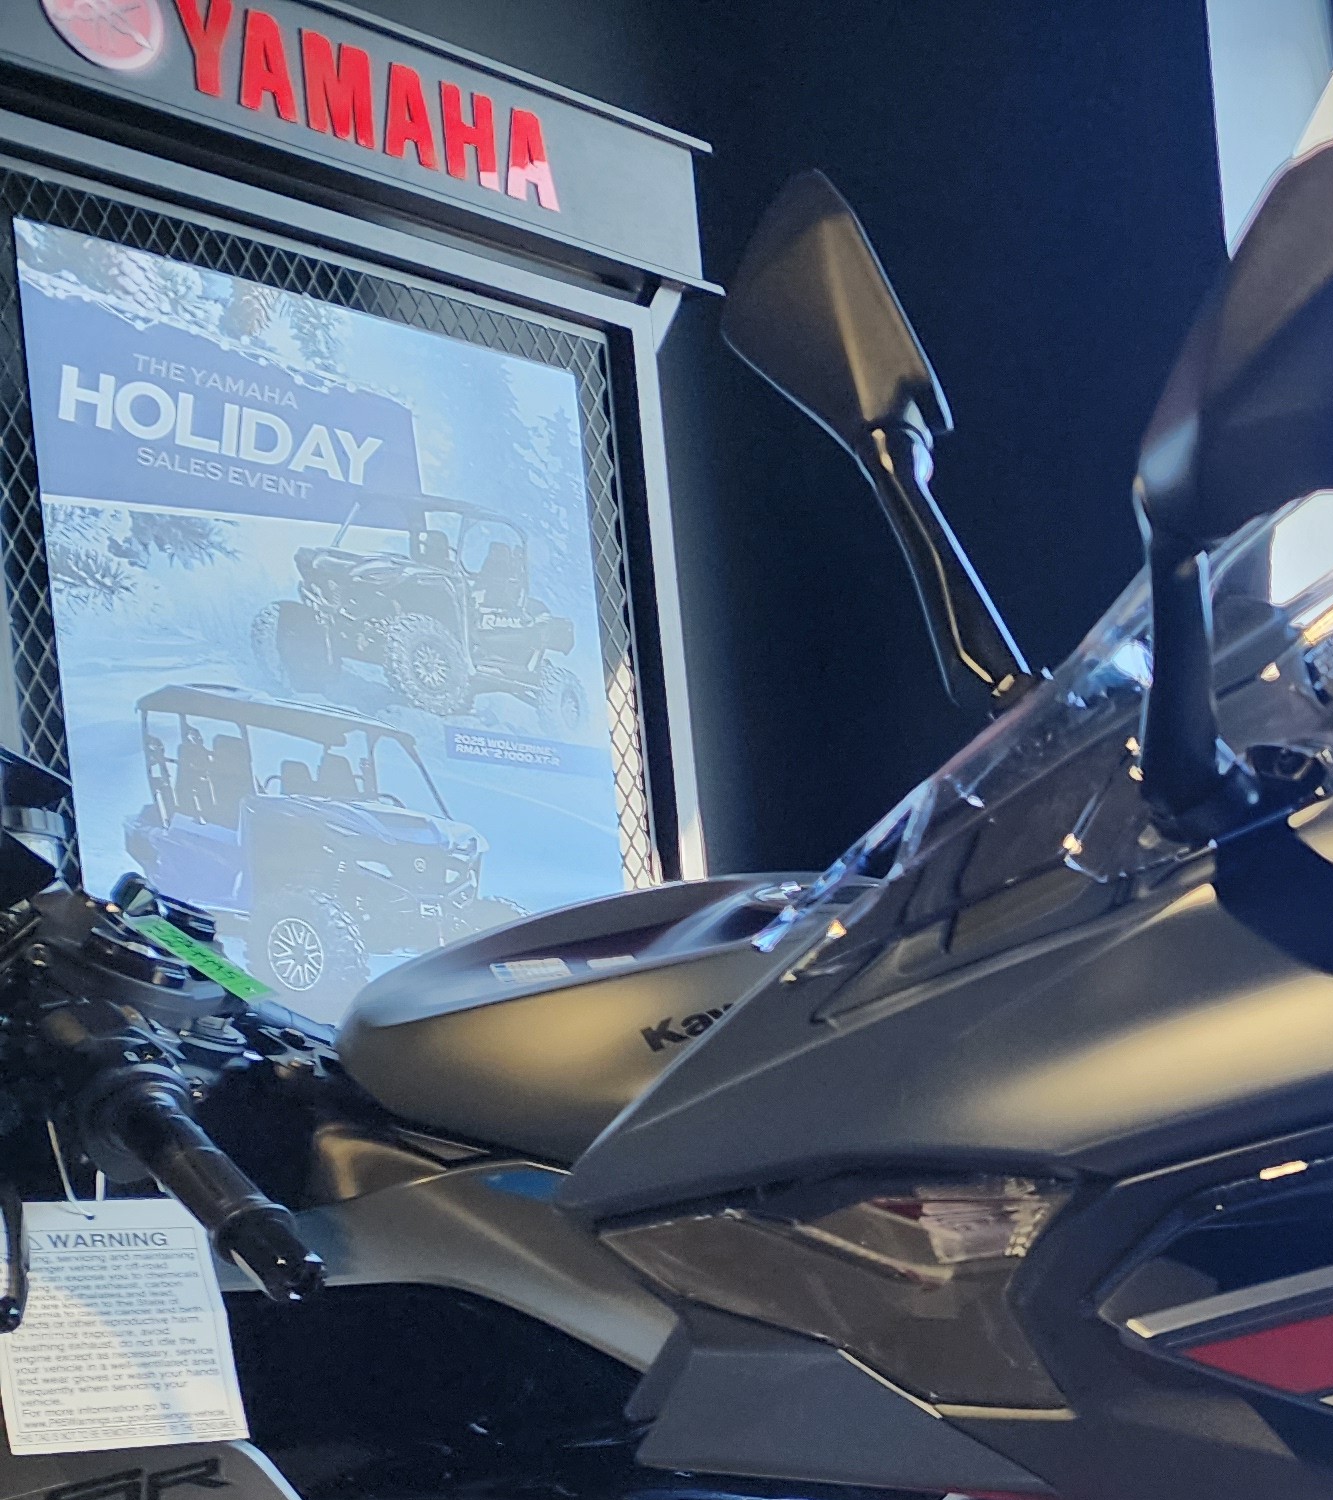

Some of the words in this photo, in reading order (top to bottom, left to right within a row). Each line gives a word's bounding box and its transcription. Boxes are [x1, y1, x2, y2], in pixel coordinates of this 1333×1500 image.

[174, 0, 561, 212] YAMAHA
[133, 353, 185, 383] THE
[191, 367, 298, 409] YAMAHA
[58, 364, 383, 485] HOLIDAY
[137, 447, 223, 487] SALES
[227, 466, 312, 499] EVENT
[47, 1232, 168, 1249] WARNING
